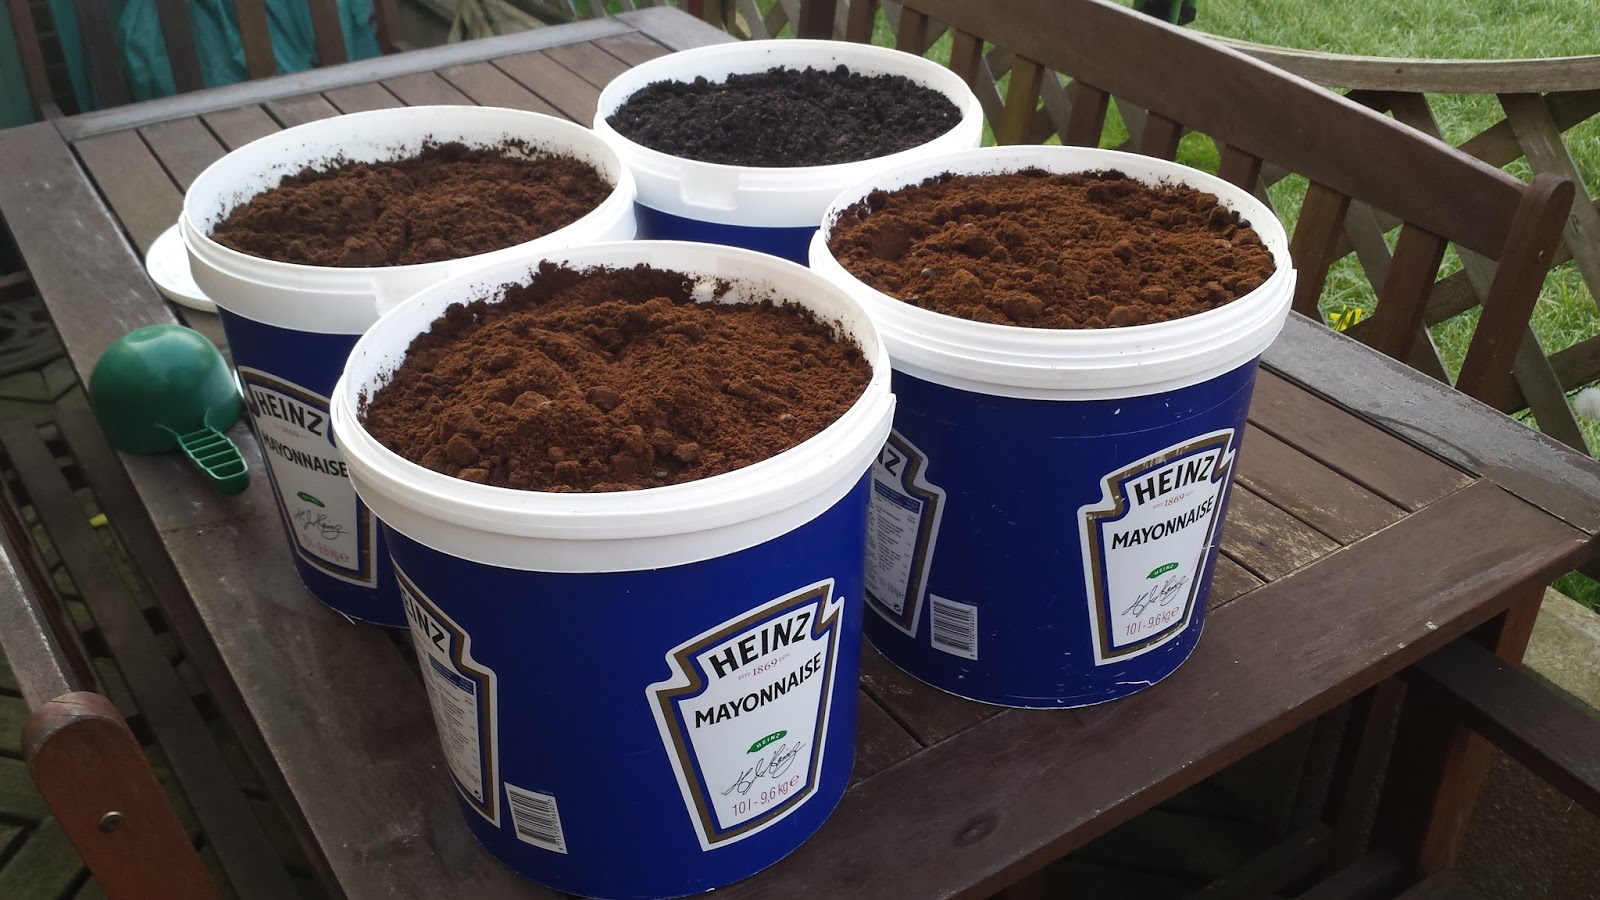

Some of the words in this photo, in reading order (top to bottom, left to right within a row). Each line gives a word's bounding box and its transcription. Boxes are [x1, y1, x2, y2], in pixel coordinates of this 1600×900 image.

[254, 391, 324, 437] HEINZ
[261, 430, 349, 478] MAYONNAISE
[1133, 455, 1215, 507] HEINZ
[1164, 493, 1185, 507] 1869
[1111, 495, 1215, 550] MAYONNAISE
[1154, 564, 1174, 576] HEINZ
[401, 587, 445, 654] EINZ
[708, 612, 811, 680] HEINZ
[752, 658, 778, 677] 1869
[695, 651, 822, 729] MAYONNAISE
[756, 733, 781, 749] HEINZ
